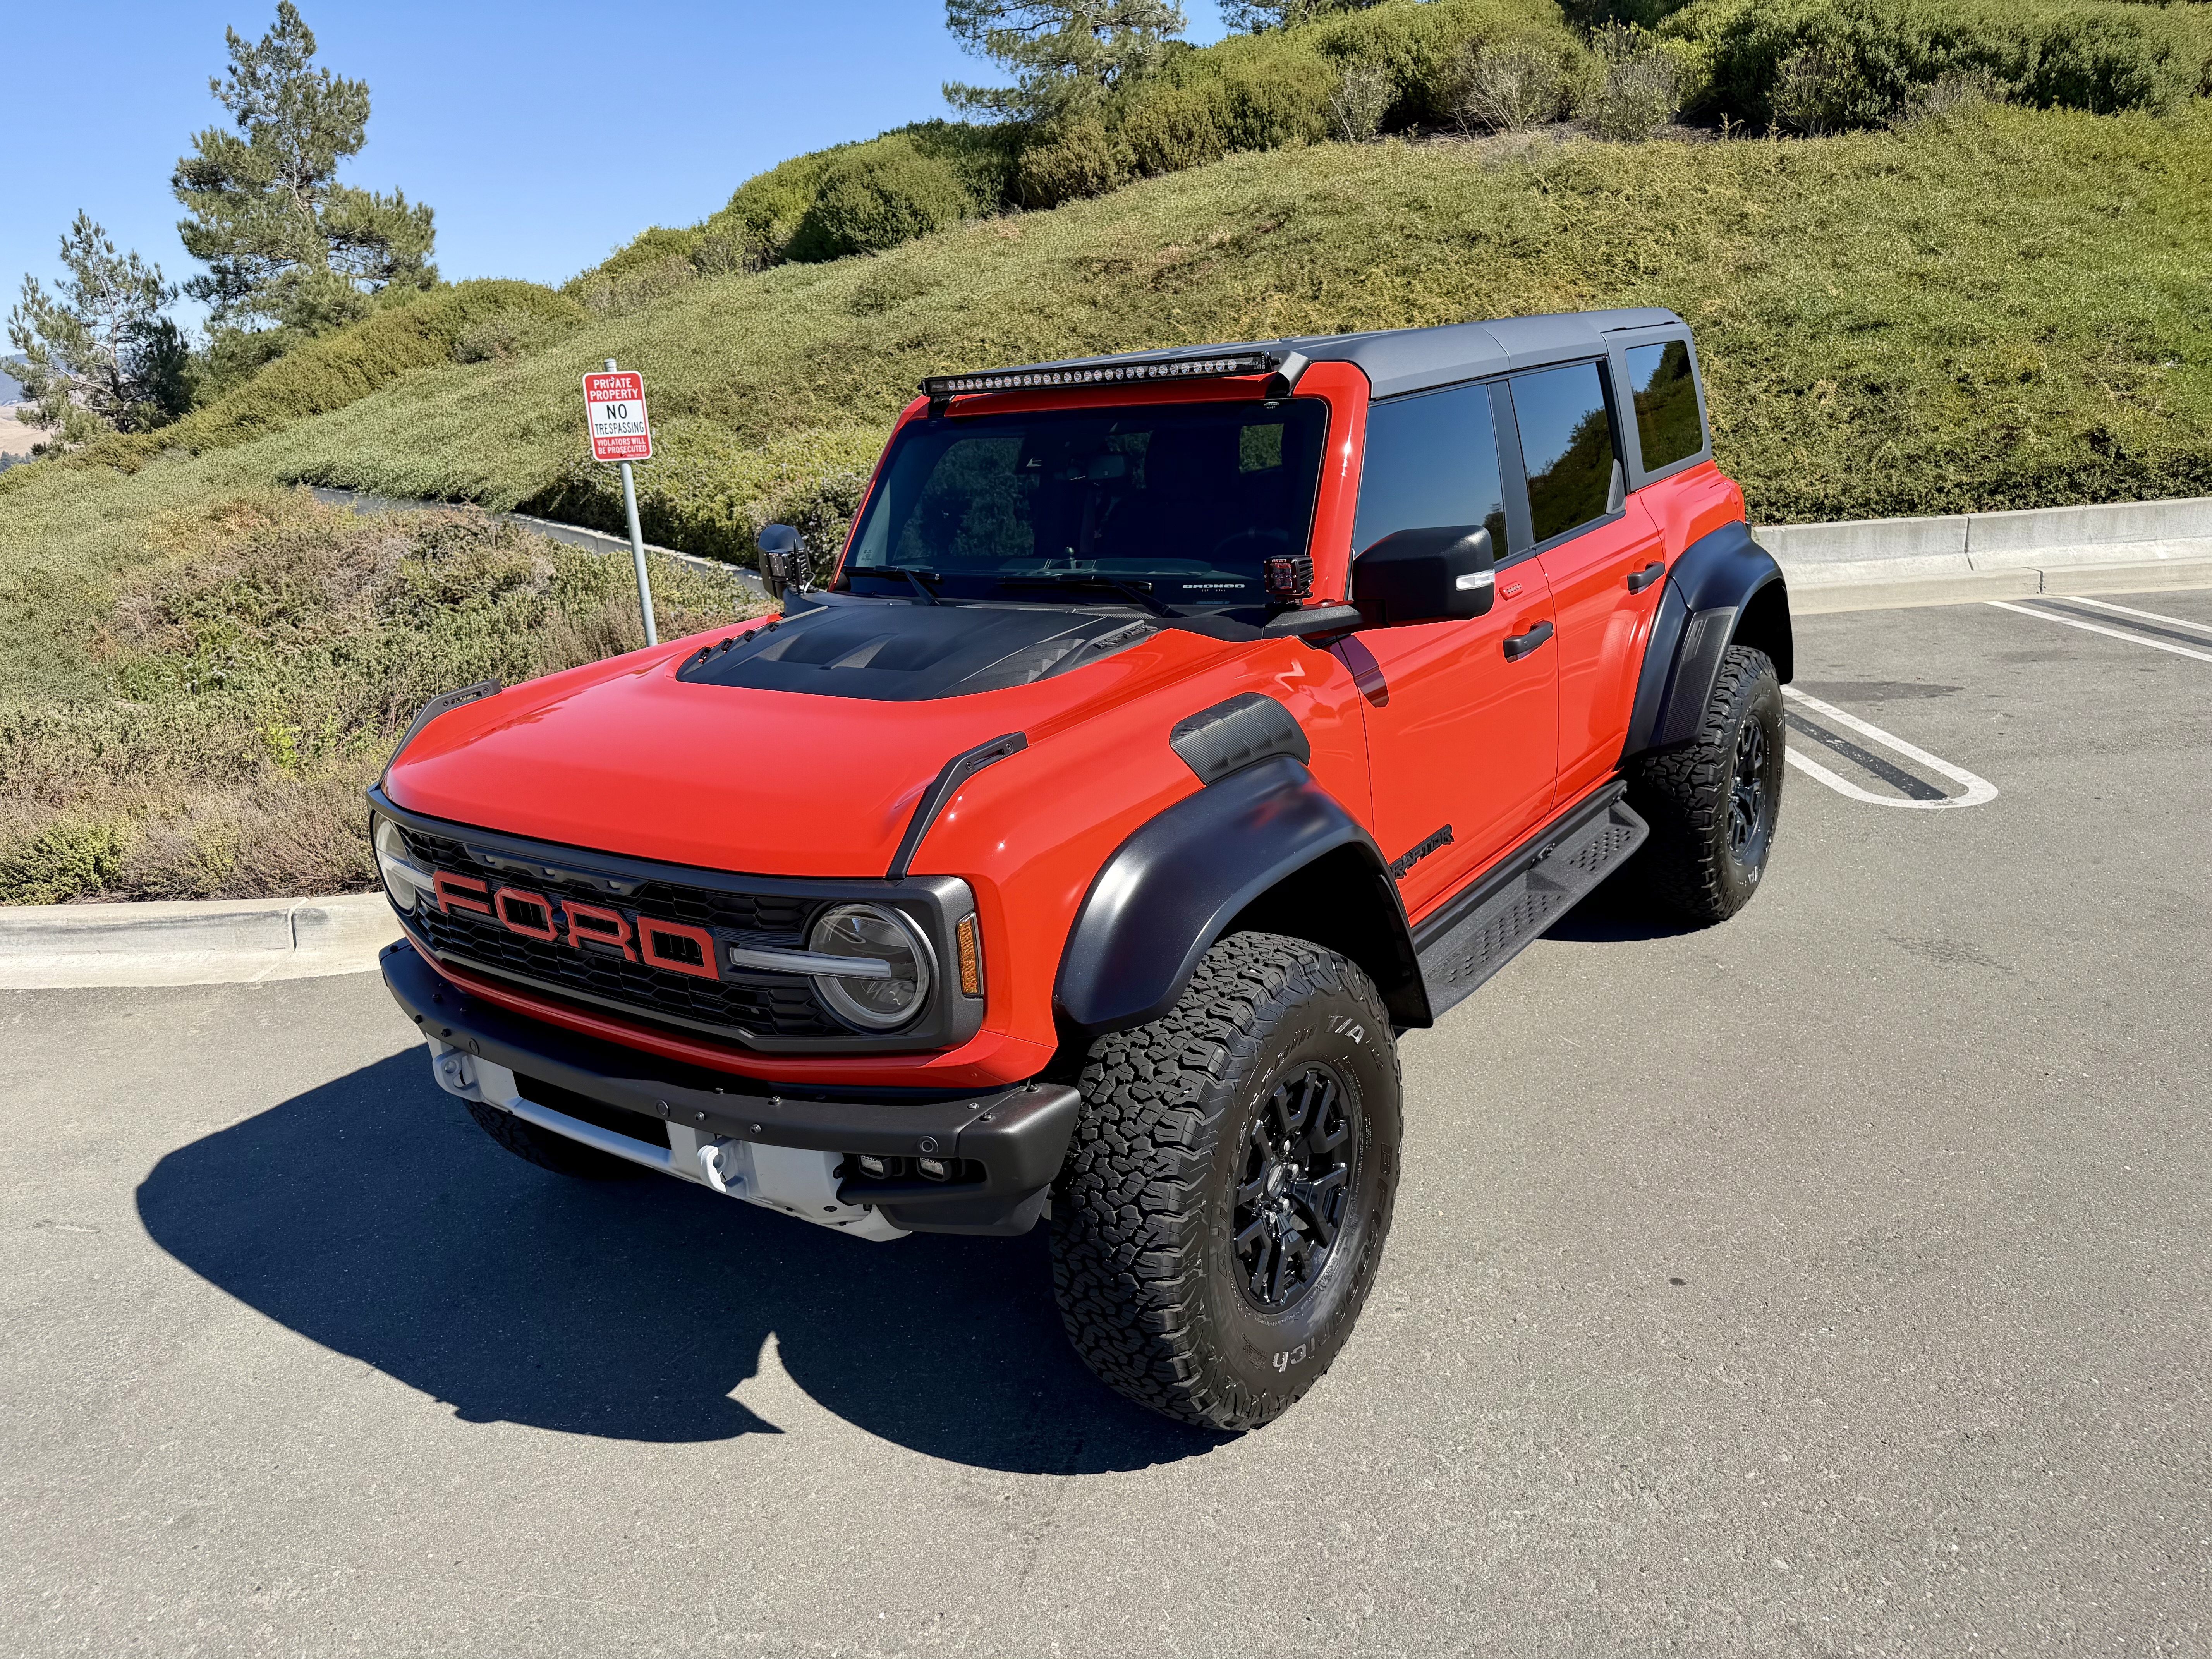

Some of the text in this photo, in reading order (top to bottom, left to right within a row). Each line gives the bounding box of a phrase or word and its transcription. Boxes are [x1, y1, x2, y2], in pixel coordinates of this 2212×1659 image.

[593, 378, 632, 389] PRIVATE
[590, 389, 638, 400] PROPERTY
[606, 404, 627, 420] NO
[594, 421, 644, 435] TRESPASSING
[596, 438, 631, 447] VIOLATORS
[608, 445, 647, 454] PROSECUTED
[1389, 824, 1455, 880] RAPTOR
[433, 870, 720, 981] FORD
[1324, 1013, 1365, 1044] T/A
